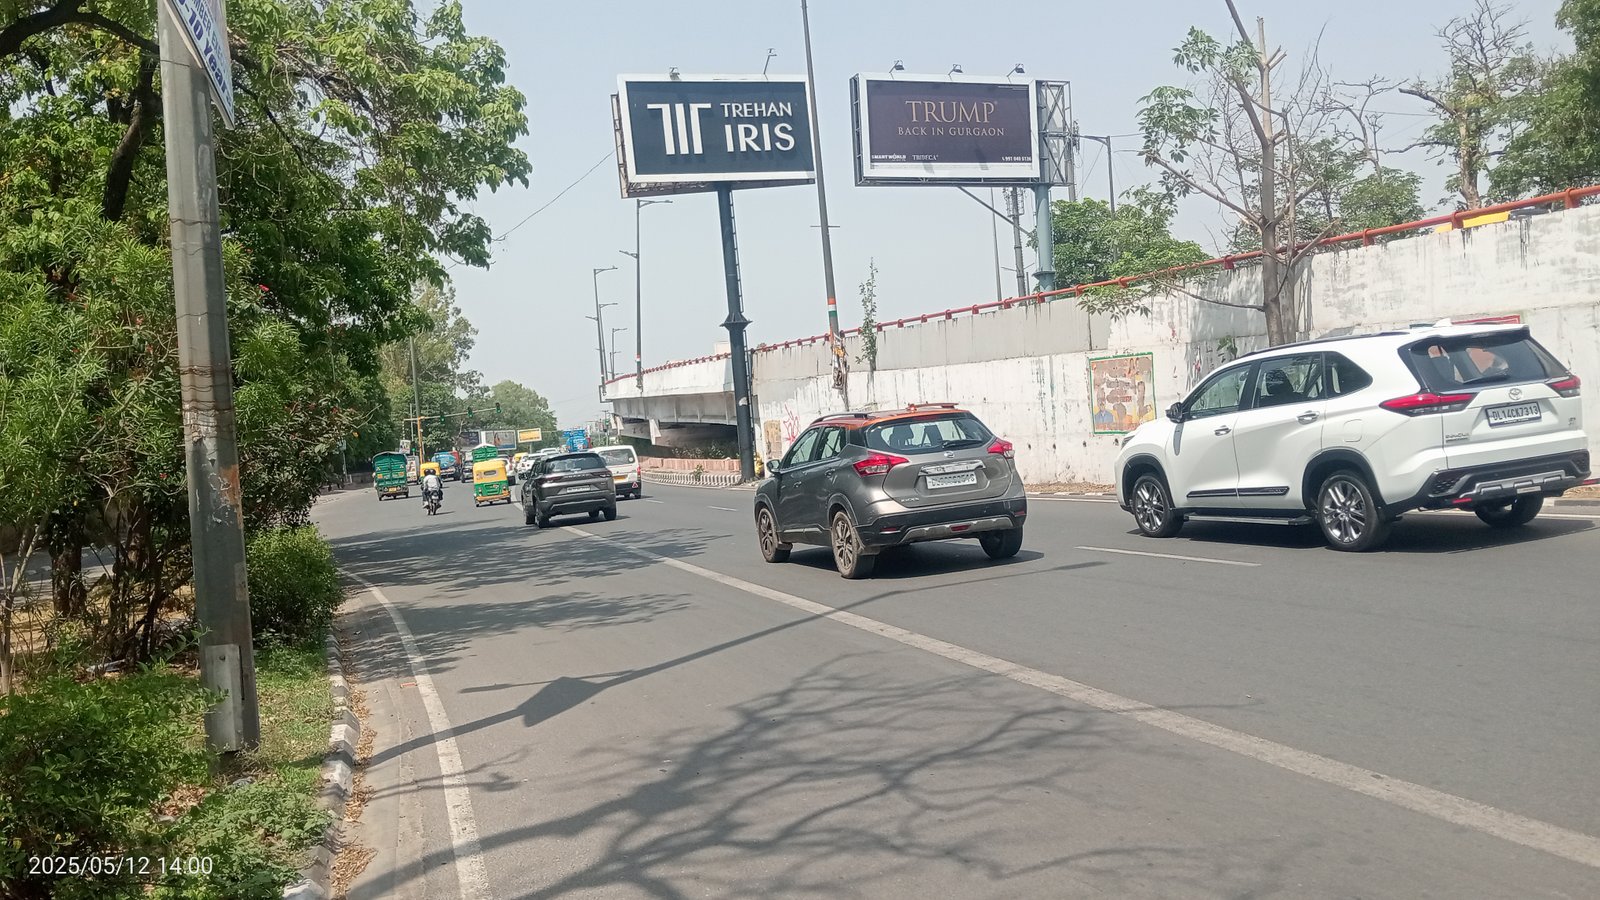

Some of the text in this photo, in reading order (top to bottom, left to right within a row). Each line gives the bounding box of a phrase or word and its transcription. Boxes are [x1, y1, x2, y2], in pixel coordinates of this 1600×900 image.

[720, 102, 792, 118] TREHAN
[905, 100, 995, 123] TRUMP
[725, 122, 795, 153] IRIS
[898, 126, 1005, 137] BACK IN GURGAON
